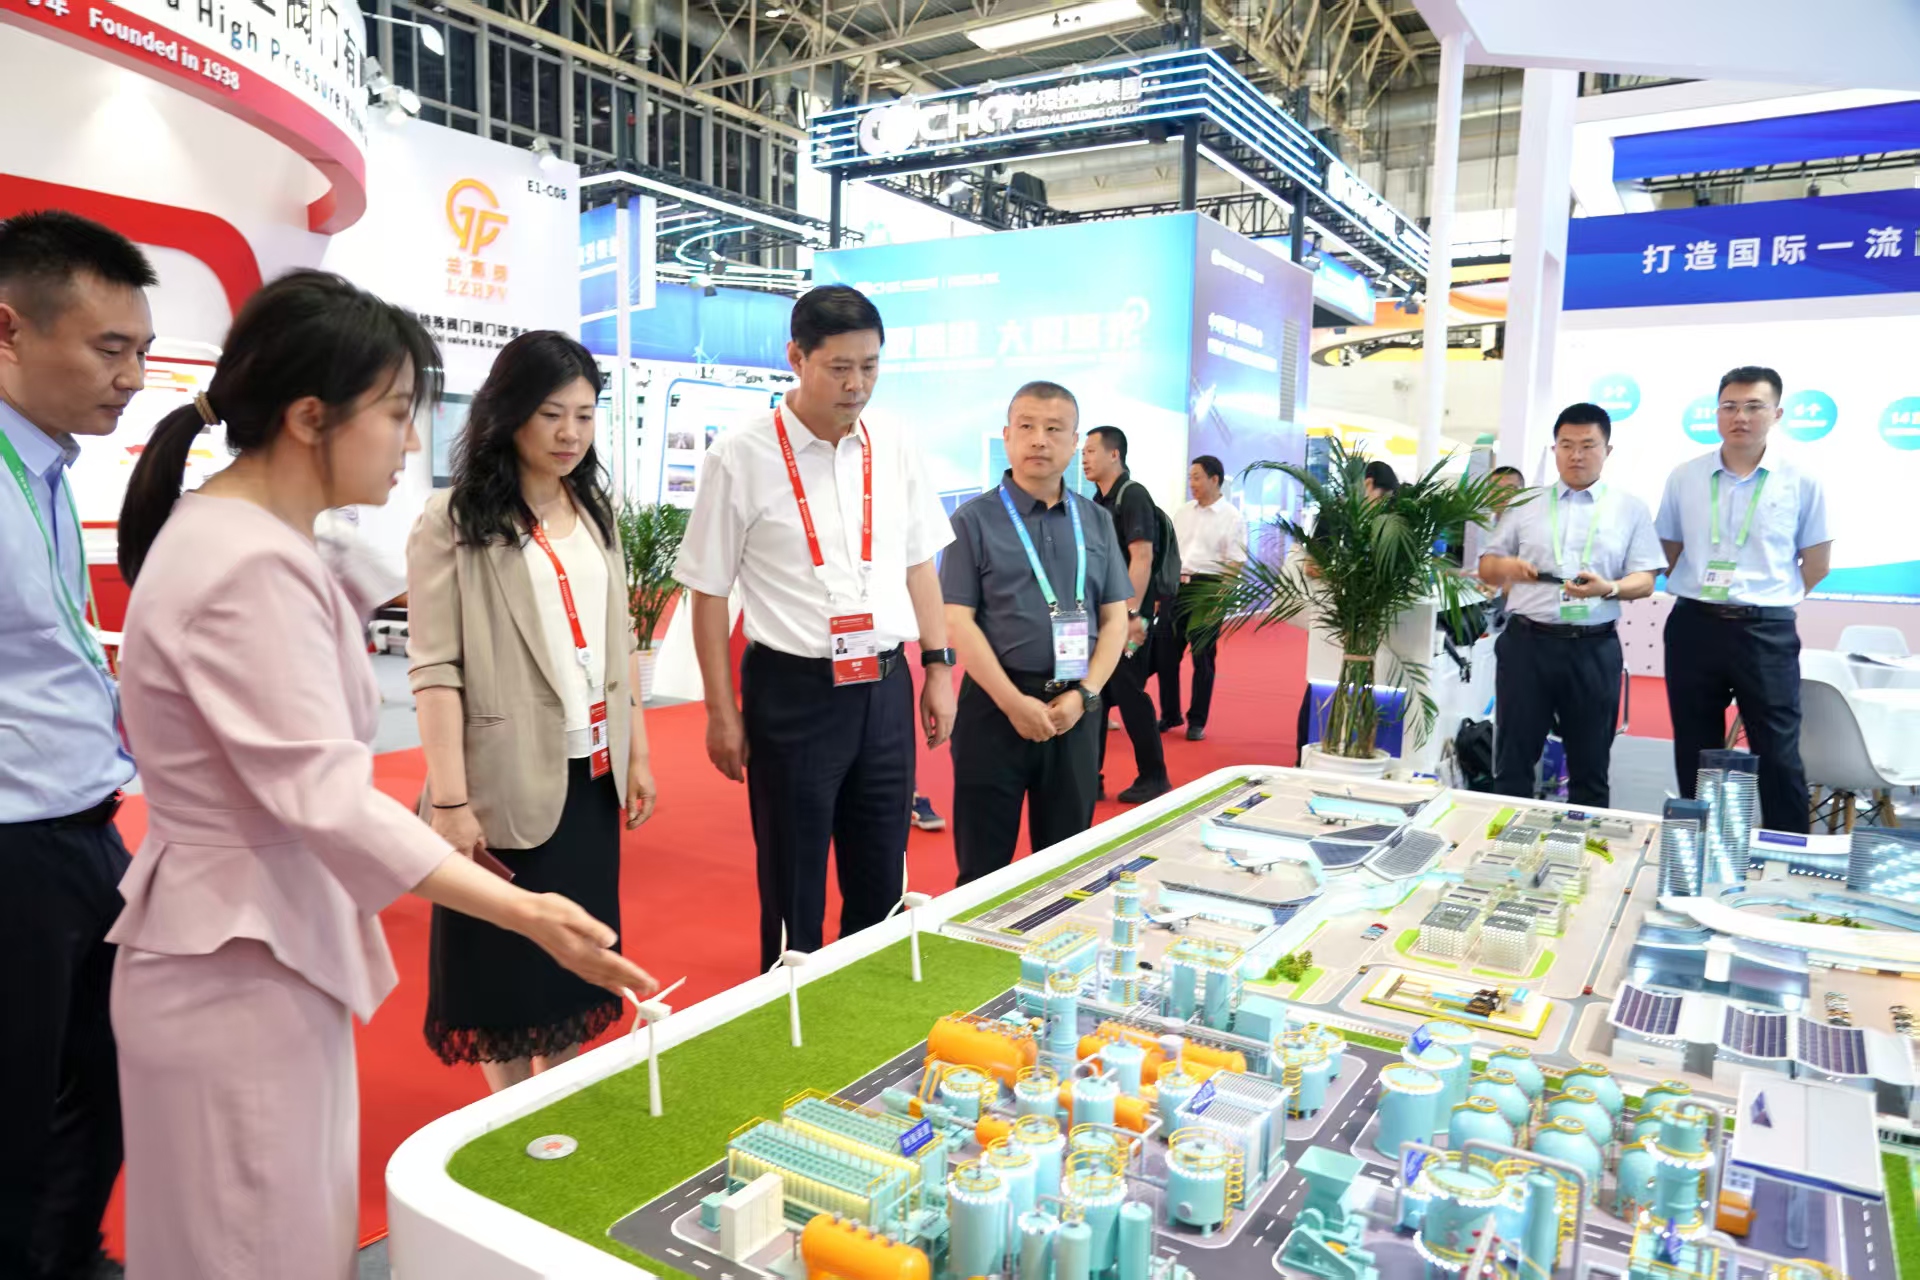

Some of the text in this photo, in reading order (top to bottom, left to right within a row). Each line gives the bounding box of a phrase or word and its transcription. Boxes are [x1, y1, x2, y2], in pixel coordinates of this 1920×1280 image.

[88, 7, 240, 91] Founded in 1938
[198, 0, 257, 53] High
[1106, 103, 1141, 118] GROUP
[1642, 226, 1920, 274] 打造国际一流
